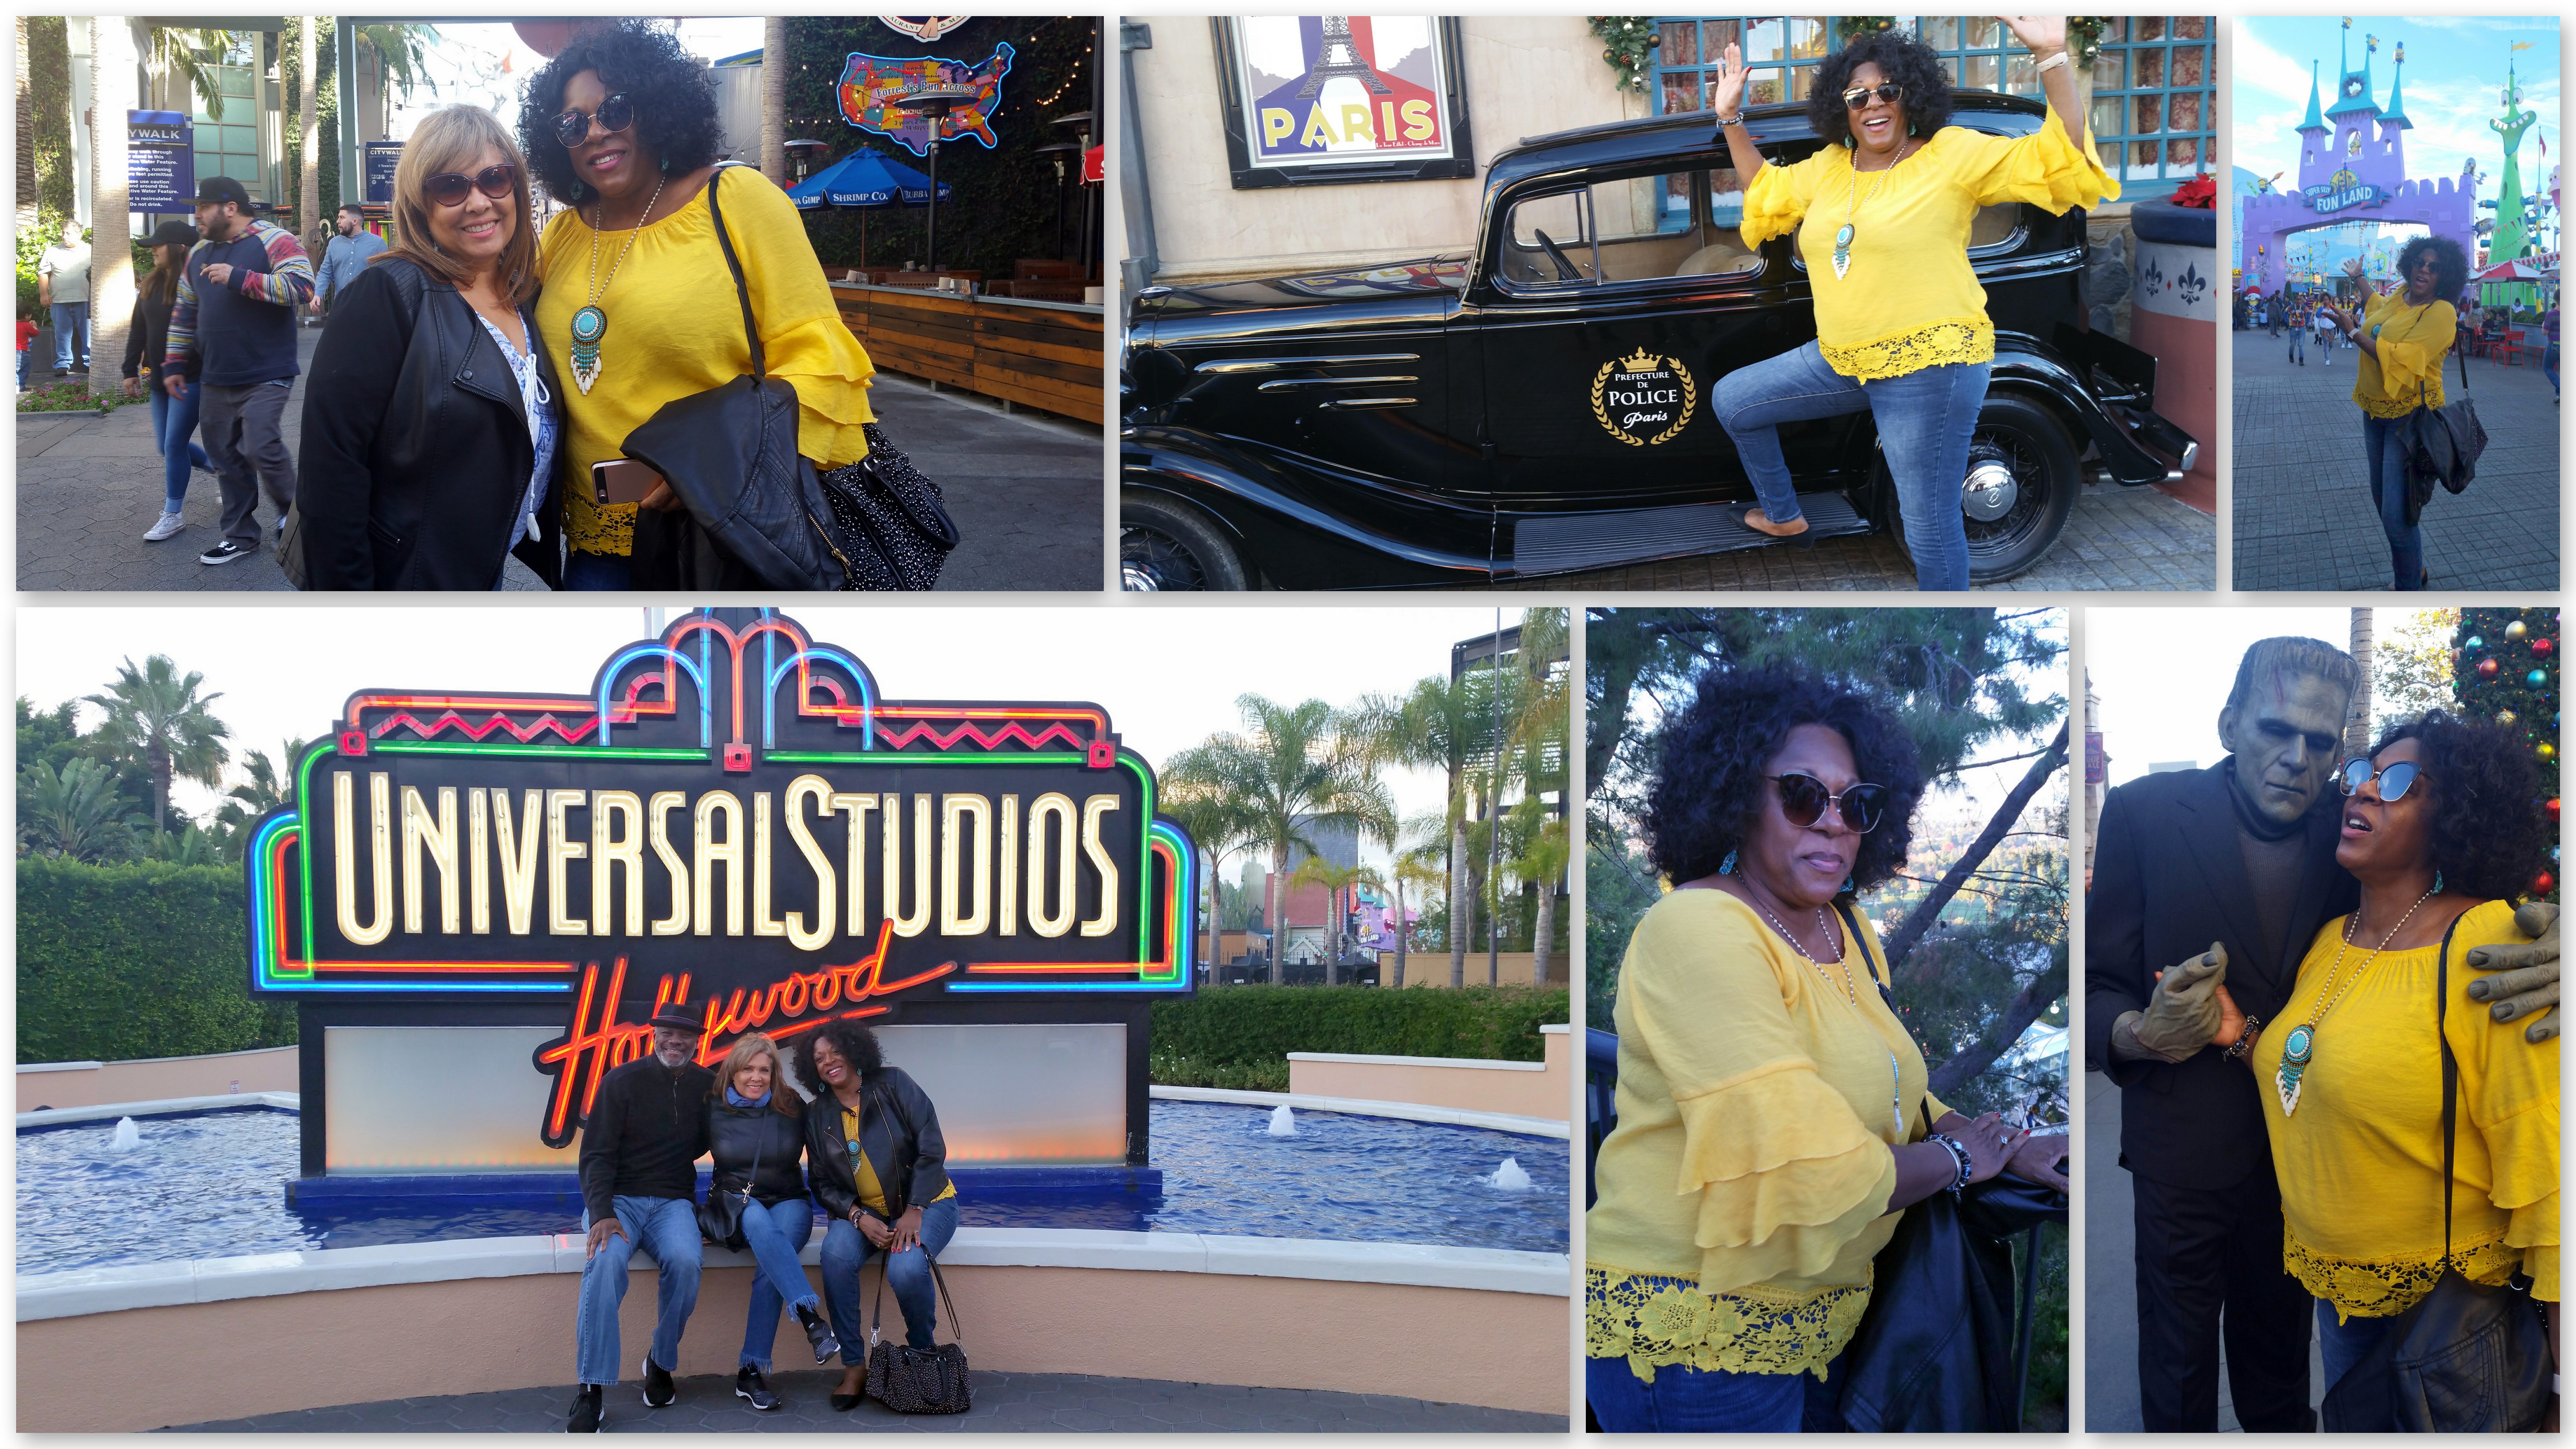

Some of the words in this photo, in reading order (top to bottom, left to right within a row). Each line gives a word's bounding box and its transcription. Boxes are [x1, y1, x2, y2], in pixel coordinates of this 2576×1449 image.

[858, 75, 866, 84] get
[876, 82, 919, 98] Forrest's
[921, 80, 940, 91] Run
[942, 80, 977, 94] Across
[1261, 99, 1435, 148] PARIS
[833, 193, 869, 202] SHRIMP
[871, 191, 889, 200] CO.
[904, 190, 928, 199] BUBBA
[2305, 186, 2320, 197] SUPER
[2320, 186, 2331, 194] SILLY
[802, 196, 820, 204] GUMP
[2316, 195, 2340, 211] FUN
[2342, 187, 2373, 207] LAND
[1615, 372, 1670, 381] PREFECTURE
[1608, 389, 1678, 406] POLICE
[1623, 411, 1668, 429] Paris
